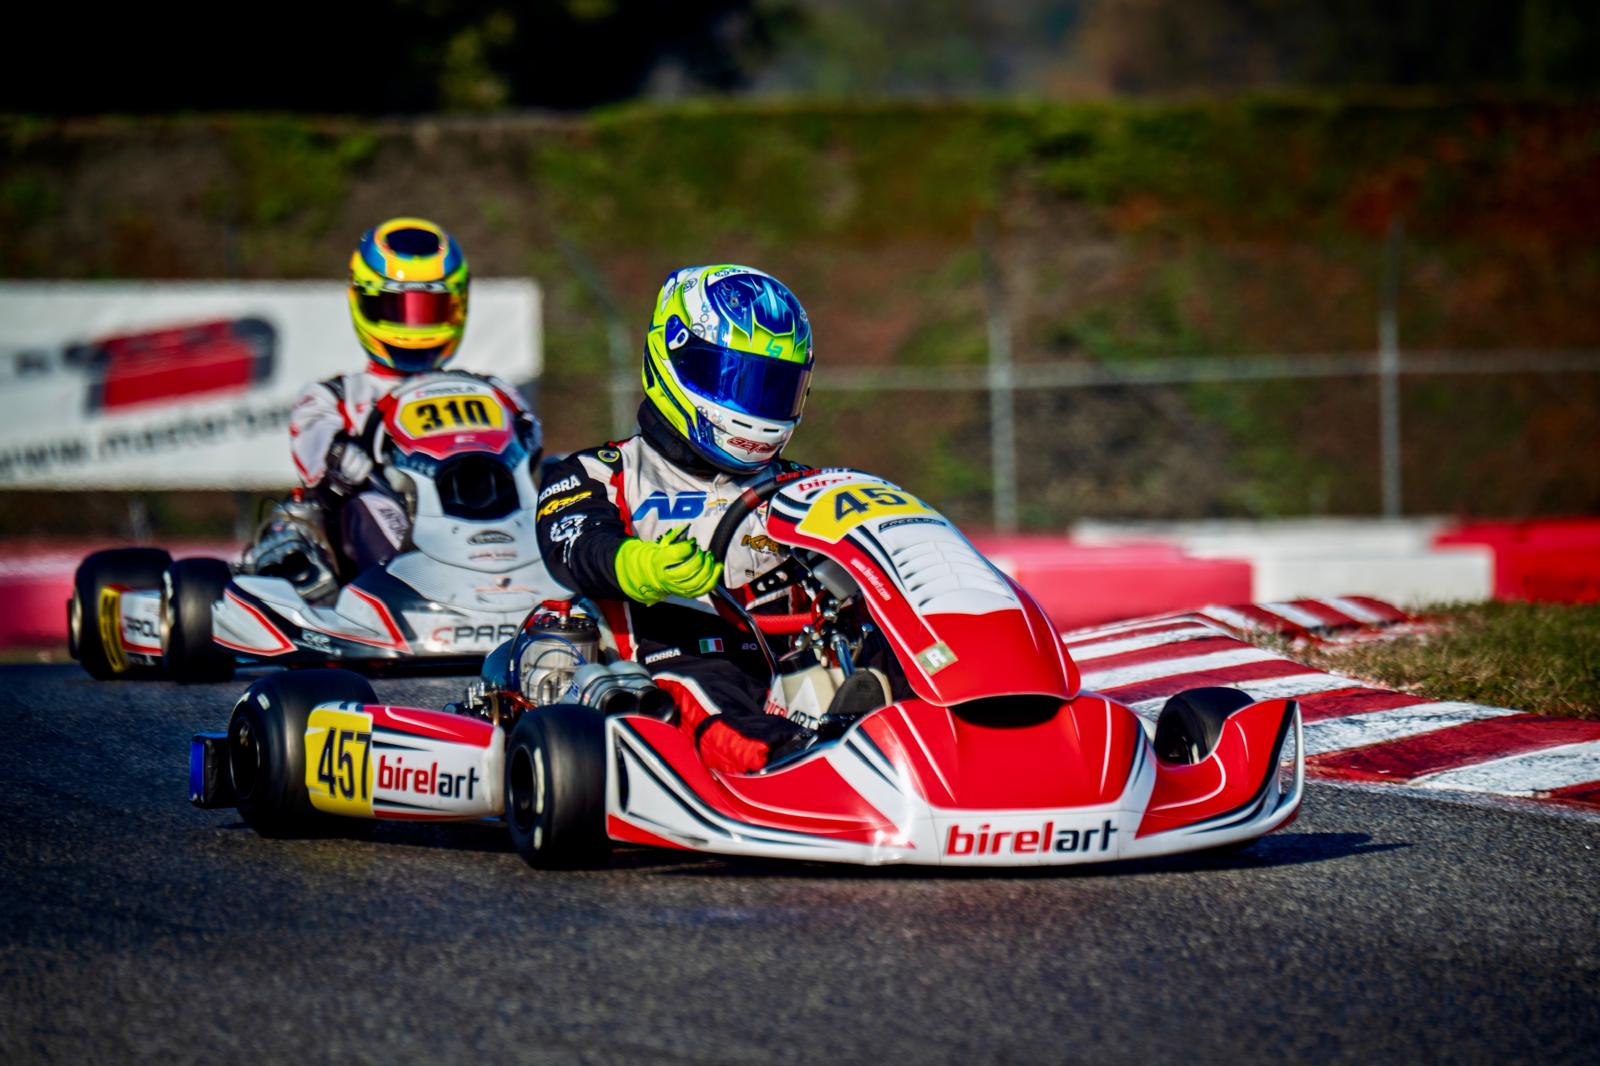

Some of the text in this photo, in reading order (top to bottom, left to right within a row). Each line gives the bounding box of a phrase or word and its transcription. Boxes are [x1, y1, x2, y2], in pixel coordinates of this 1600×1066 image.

[416, 400, 491, 432] 310
[834, 486, 912, 523] 45
[645, 647, 682, 665] KOBRA
[317, 726, 373, 800] 457
[377, 754, 480, 801] birelart
[944, 819, 1119, 856] birelart
